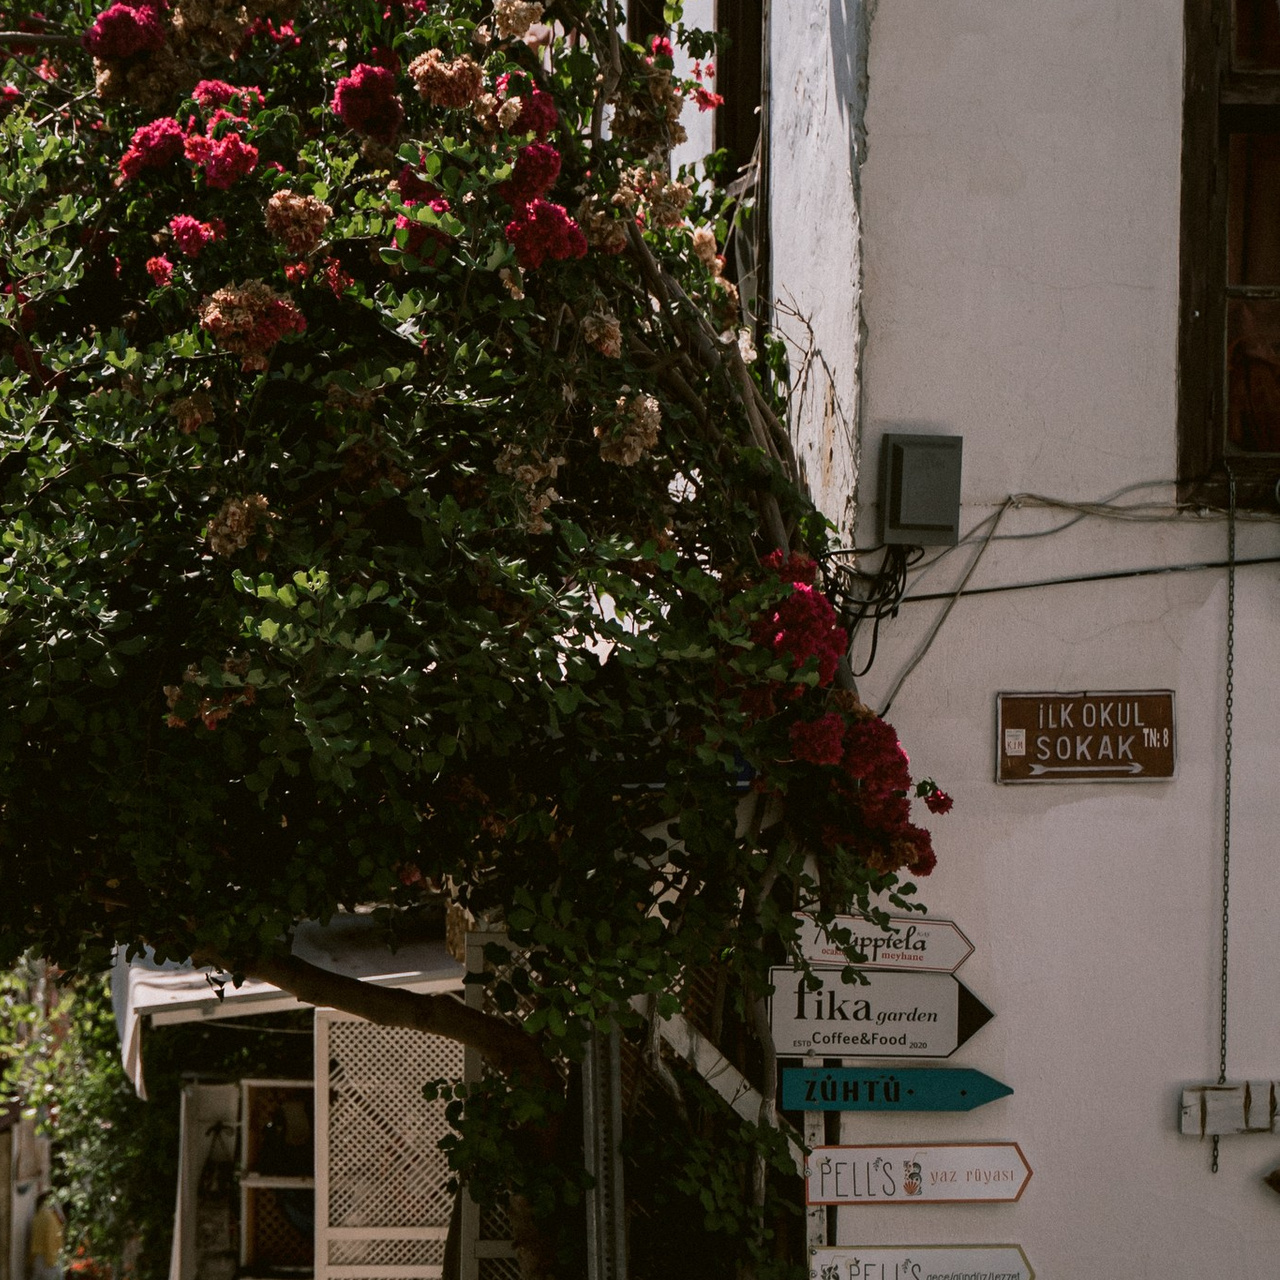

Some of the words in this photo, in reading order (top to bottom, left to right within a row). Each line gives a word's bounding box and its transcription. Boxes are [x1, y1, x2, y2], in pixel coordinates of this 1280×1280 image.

[1082, 701, 1145, 728] OKUL
[1036, 735, 1136, 761] SOKAK
[1163, 727, 1169, 748] 8
[881, 951, 924, 962] meyhane
[793, 976, 874, 1021] fika
[876, 1007, 938, 1025] garden
[793, 1040, 812, 1048] ESTD
[812, 1031, 907, 1046] Coffee&Food
[909, 1041, 928, 1049] 2020
[930, 1170, 957, 1186] yaz
